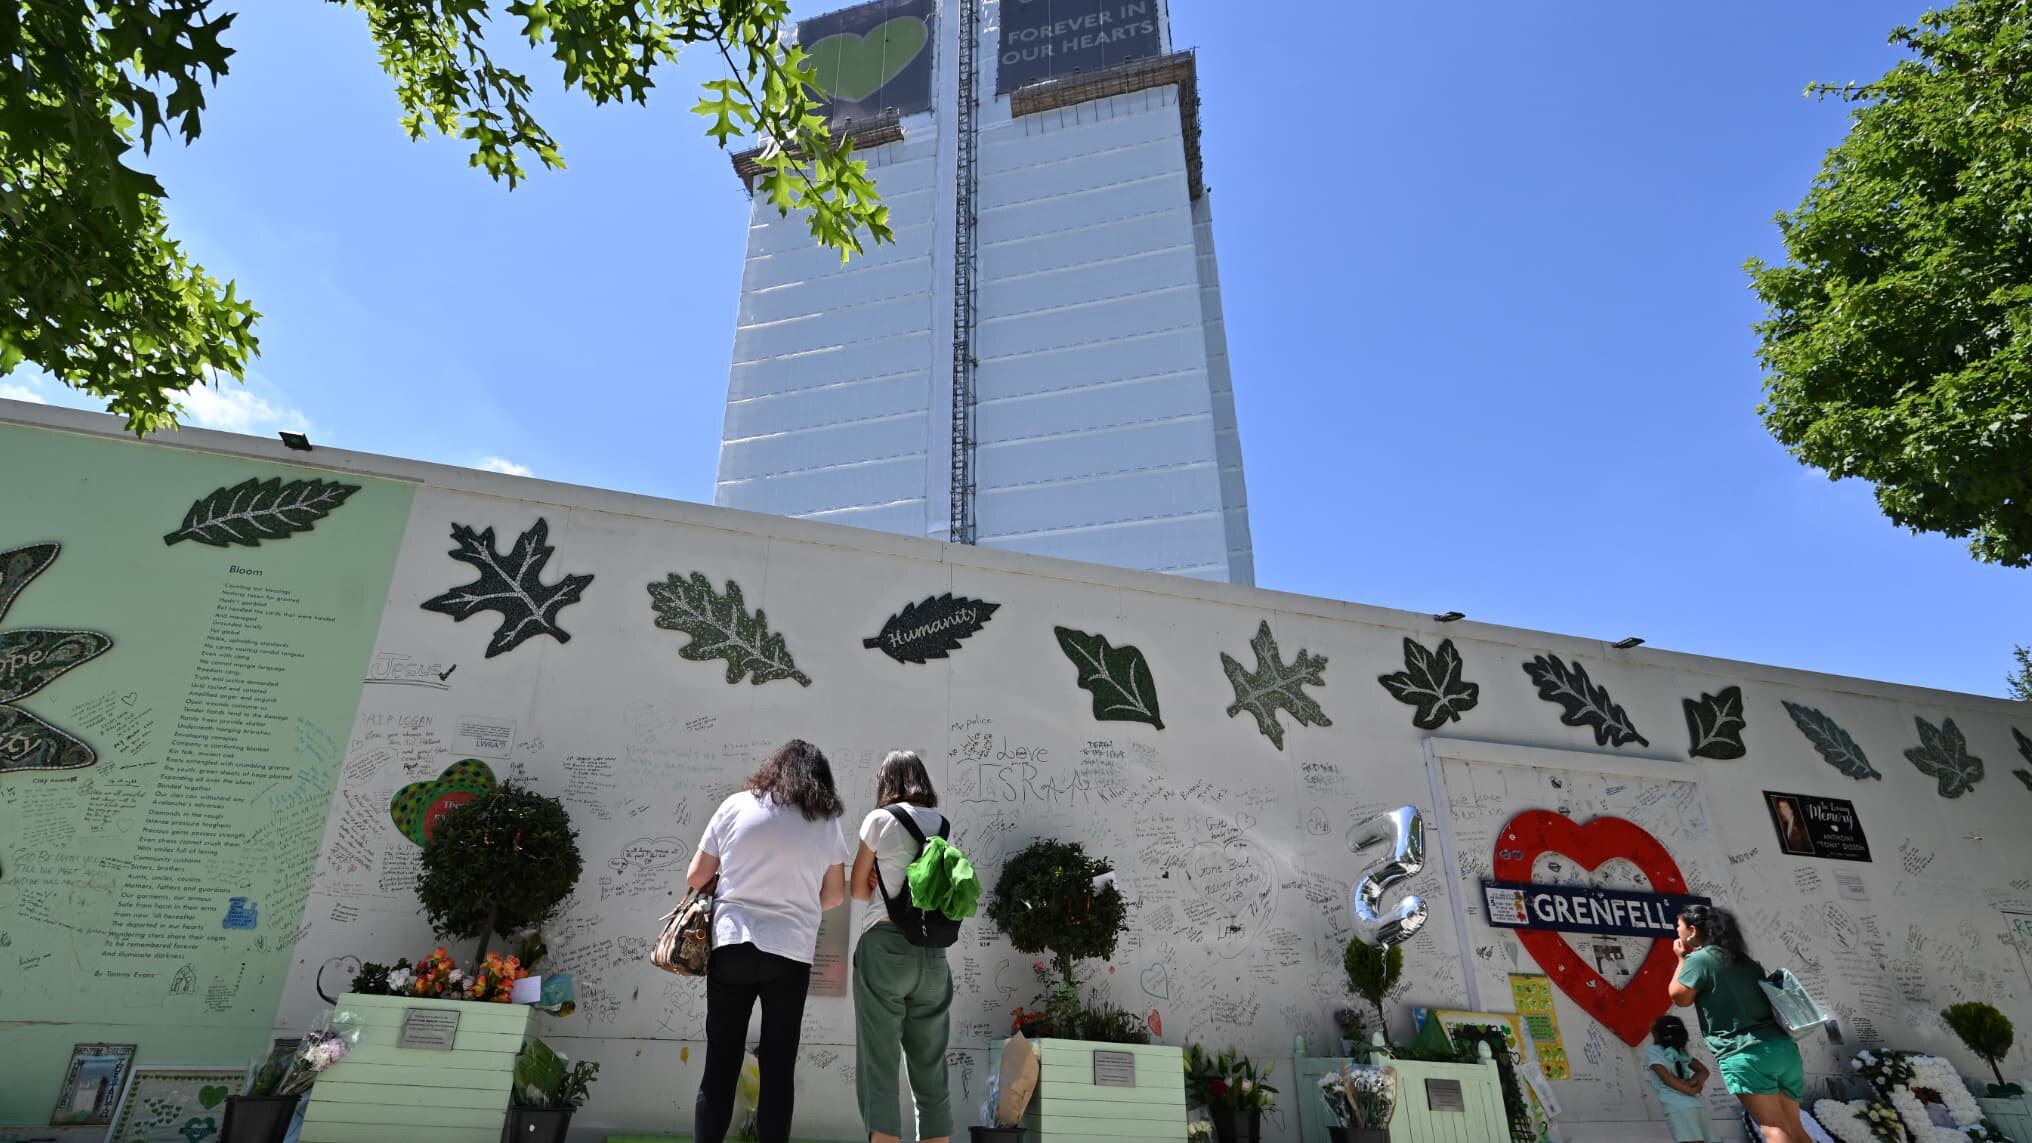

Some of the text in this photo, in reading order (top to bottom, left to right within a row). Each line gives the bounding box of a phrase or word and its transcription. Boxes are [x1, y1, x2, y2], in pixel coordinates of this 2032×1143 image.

[1008, 1, 1147, 45] FOREVER IN
[1001, 19, 1155, 65] OUR HEARTS
[229, 565, 263, 577] Bloom
[888, 607, 977, 648] Humanity
[996, 736, 1048, 763] Love
[1809, 803, 1853, 830] Memory
[1823, 834, 1854, 842] ANTHONY
[1533, 893, 1675, 930] GRENFELL
